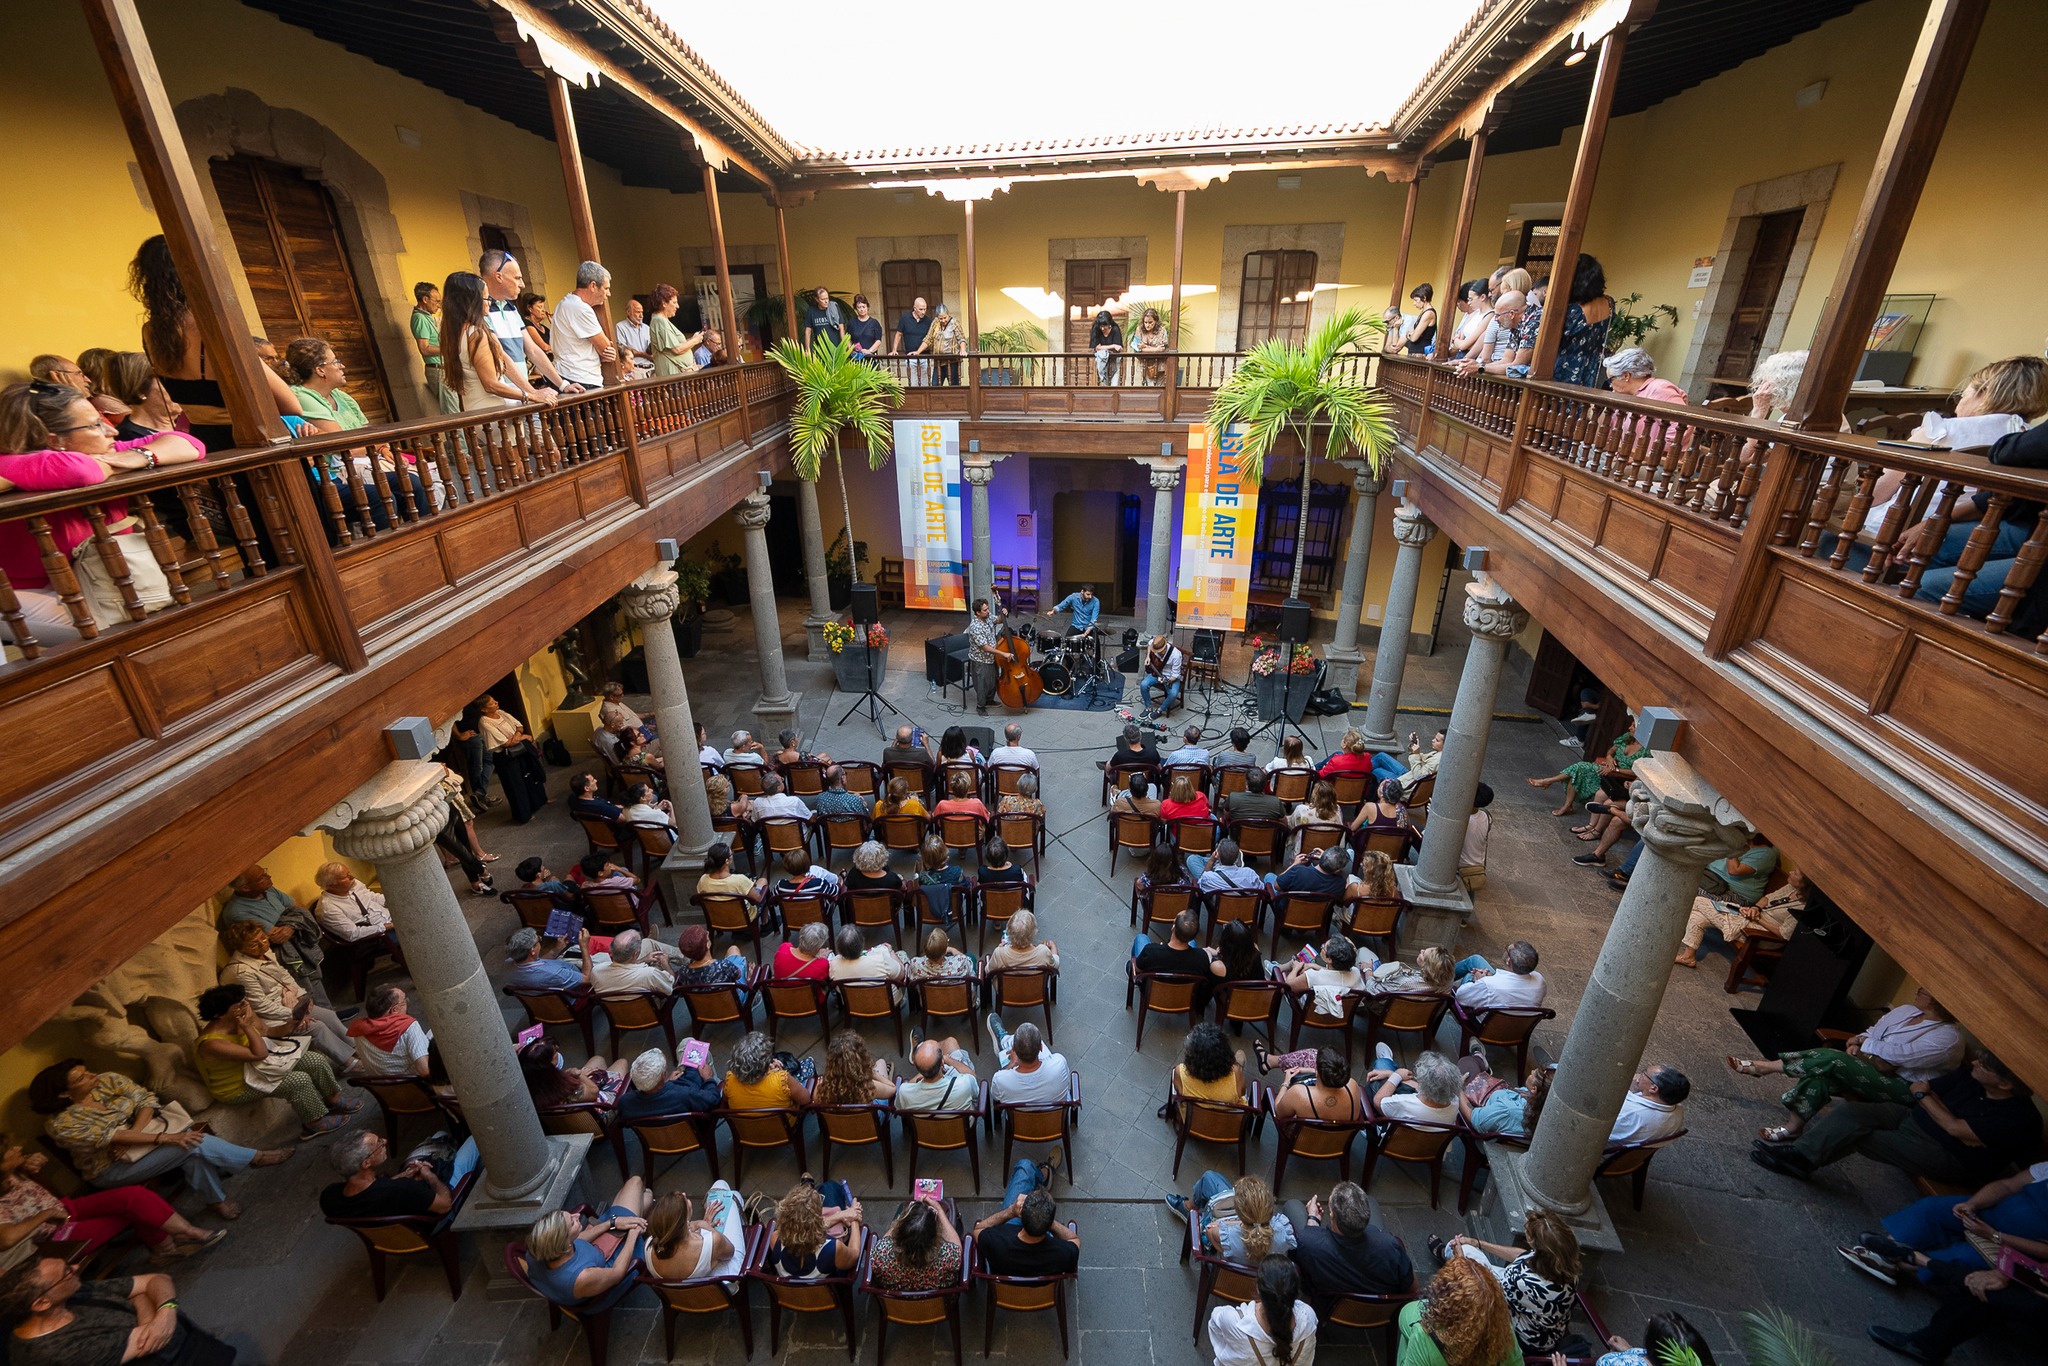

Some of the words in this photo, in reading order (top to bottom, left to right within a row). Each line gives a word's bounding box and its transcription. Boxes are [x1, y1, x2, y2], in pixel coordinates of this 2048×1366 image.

[921, 425, 942, 464] ISLA
[1217, 433, 1244, 475] ISLA
[923, 471, 944, 494] DE
[1203, 474, 1211, 488] para
[1215, 483, 1239, 506] DE
[925, 500, 947, 543] ARTE
[1210, 513, 1236, 559] ARTE
